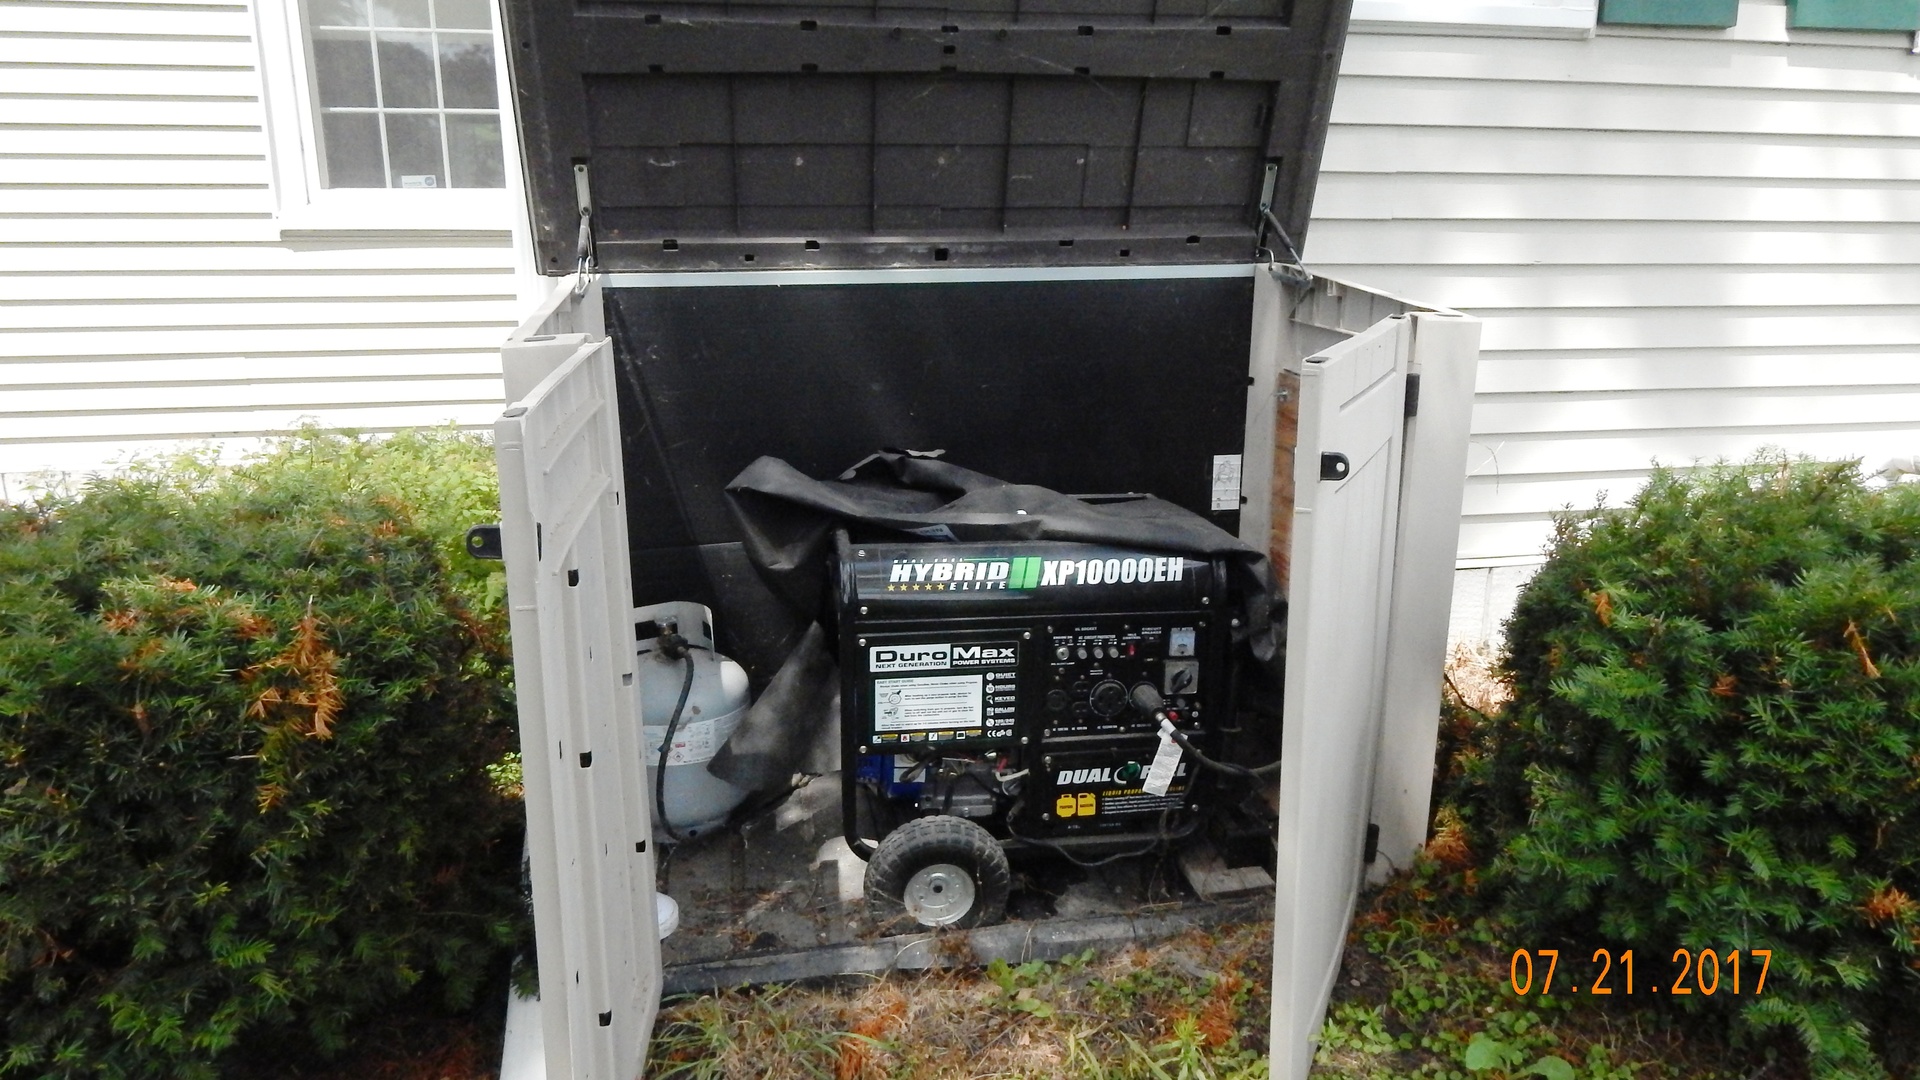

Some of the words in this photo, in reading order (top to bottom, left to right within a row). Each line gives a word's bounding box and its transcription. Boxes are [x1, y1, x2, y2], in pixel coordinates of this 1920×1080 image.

[889, 561, 1010, 583] HYBRID
[1039, 556, 1184, 586] XP10000EH
[949, 581, 1007, 591] ELITE
[875, 650, 948, 663] Duro
[952, 646, 1015, 660] Max
[981, 657, 1016, 665] SYSTEMS
[1056, 767, 1112, 785] DUAL
